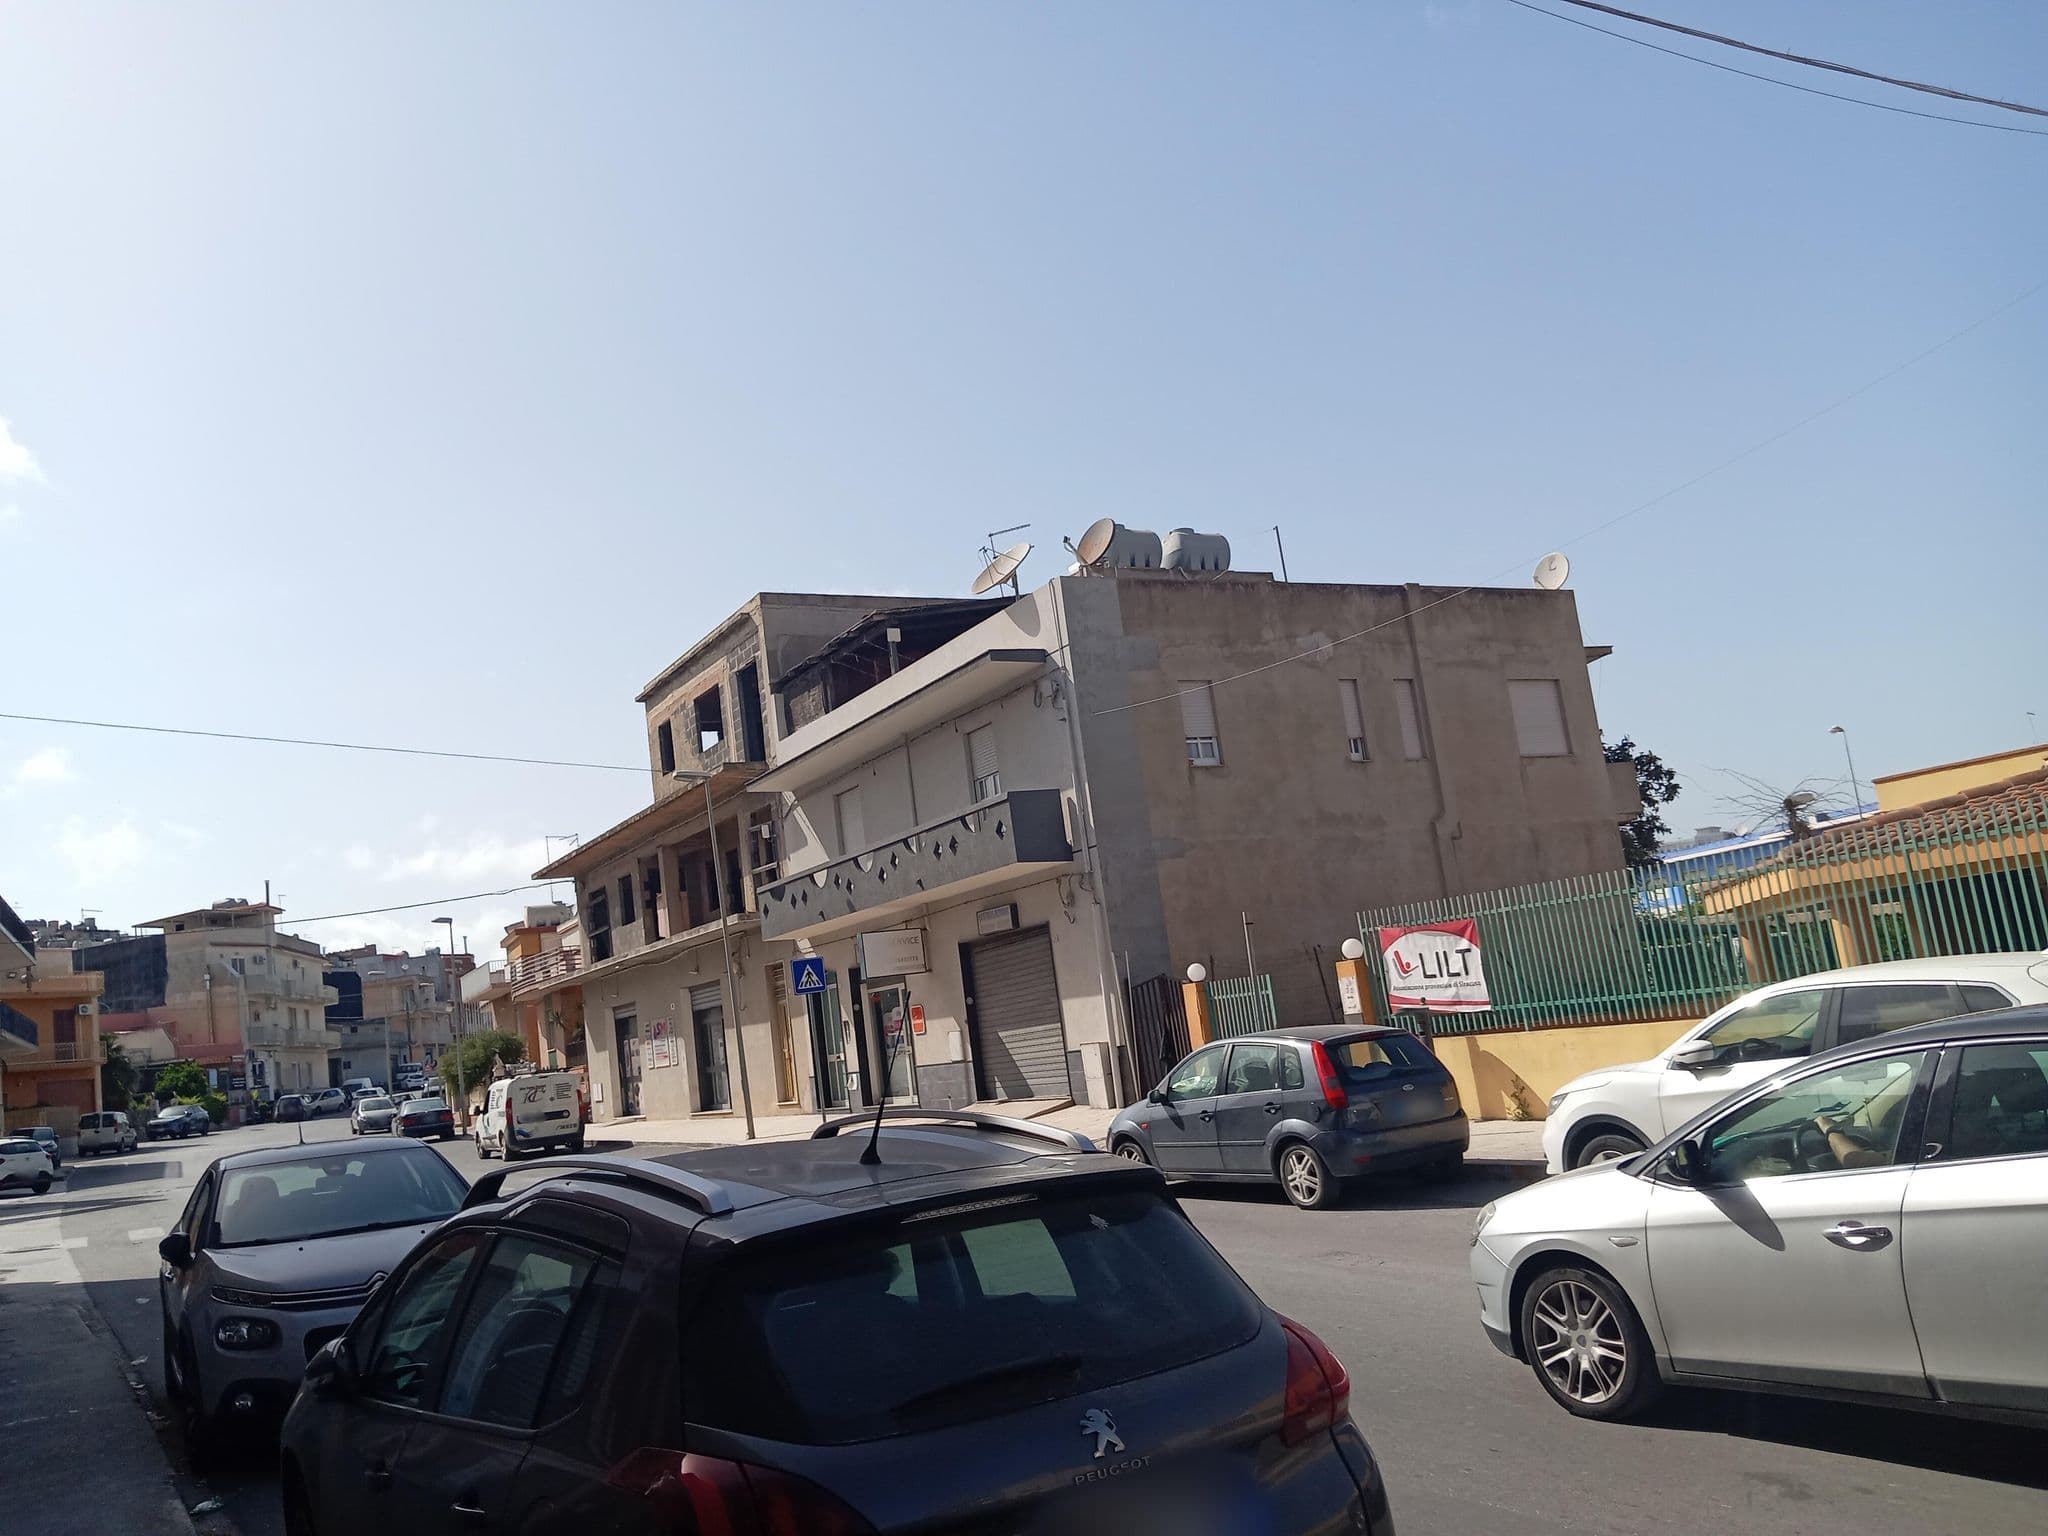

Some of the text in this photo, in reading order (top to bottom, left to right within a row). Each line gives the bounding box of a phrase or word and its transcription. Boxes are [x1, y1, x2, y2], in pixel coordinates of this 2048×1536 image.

[1418, 948, 1472, 979] LILT
[1459, 980, 1482, 988] Siracusa
[1074, 1455, 1151, 1486] PEUGEOT
